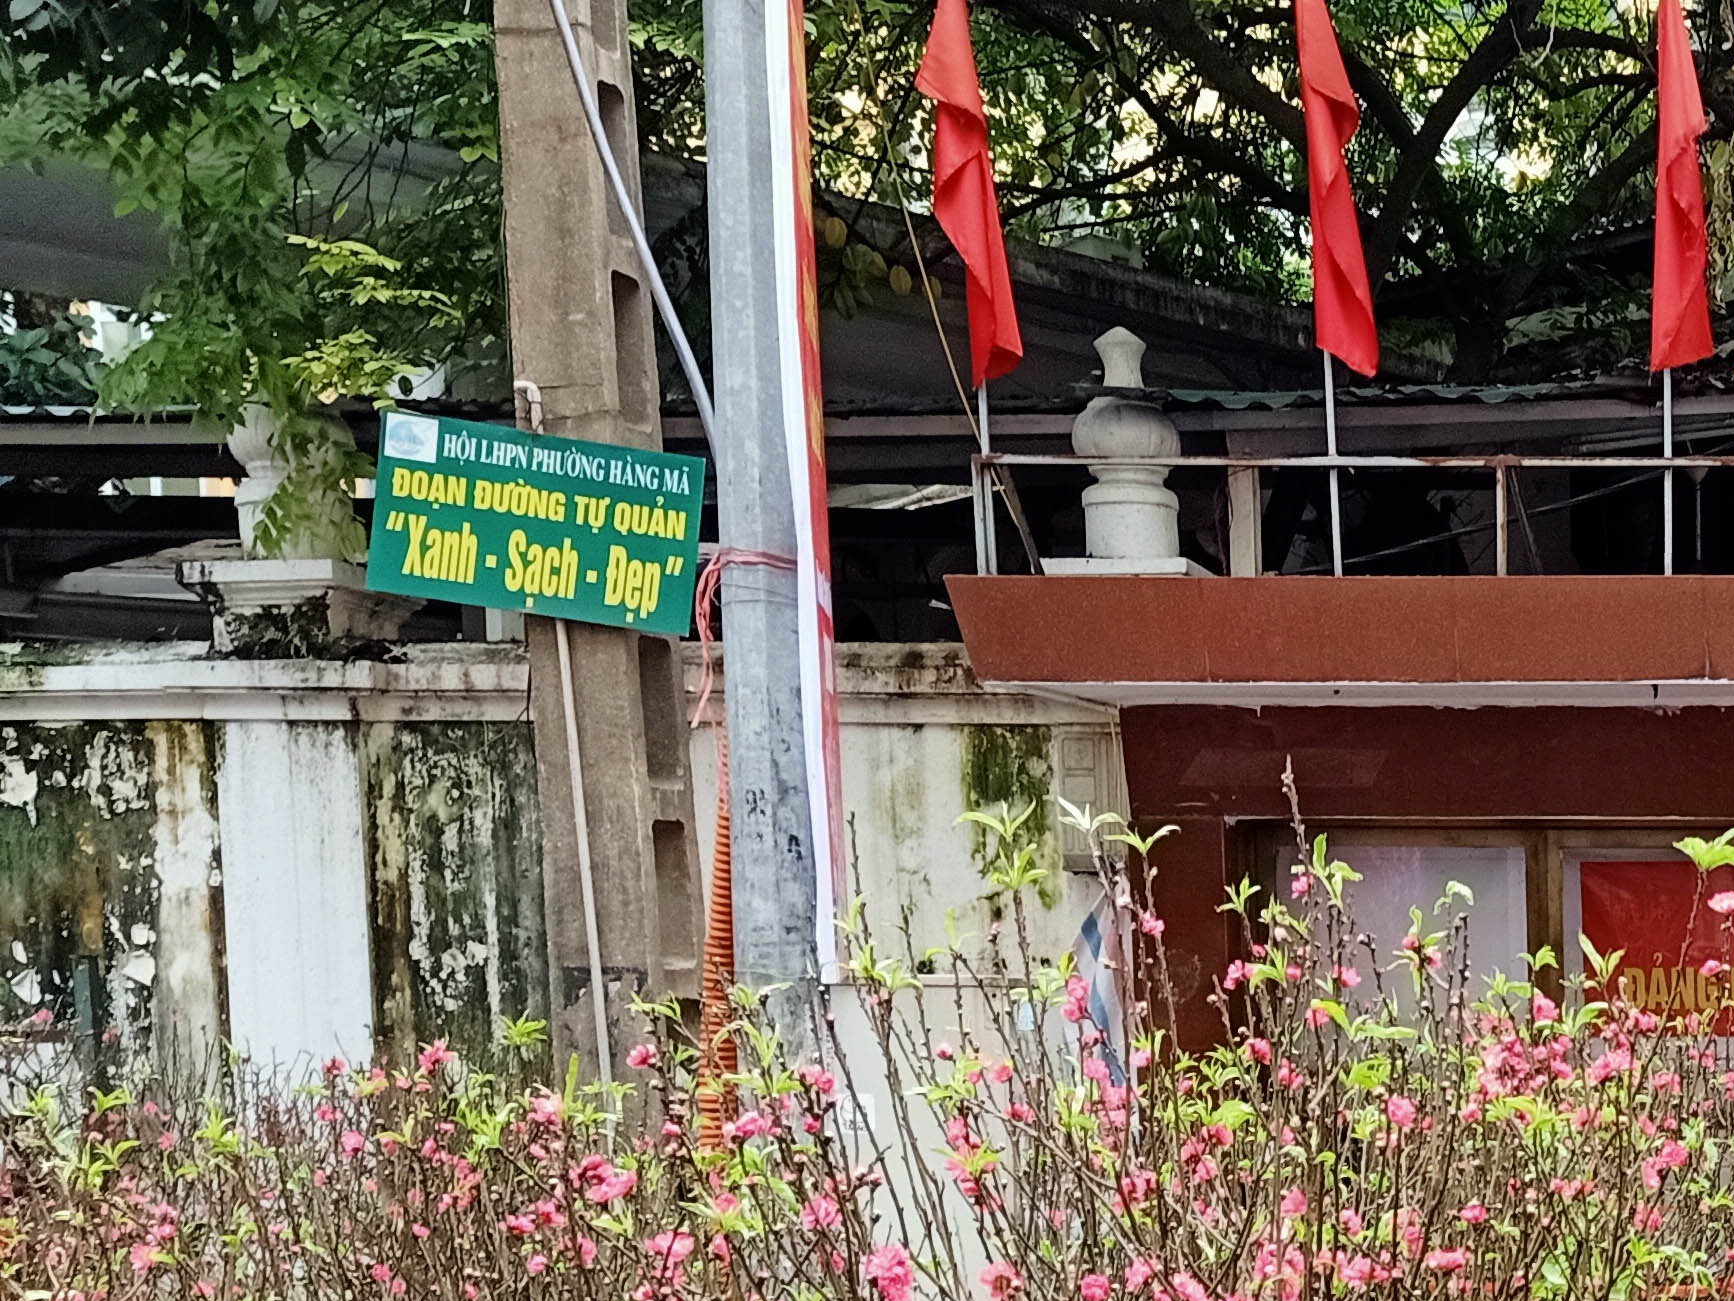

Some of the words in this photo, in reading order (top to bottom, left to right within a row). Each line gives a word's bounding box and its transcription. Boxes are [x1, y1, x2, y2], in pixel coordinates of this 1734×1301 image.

[443, 430, 477, 466] HỘI
[480, 439, 531, 469] LHPN
[531, 446, 606, 482] PHƯỜNG
[608, 455, 660, 488] HÀNG
[662, 463, 690, 495] MÃ
[391, 467, 467, 509] ĐOẠN
[473, 477, 566, 522] ĐƯỜNG
[574, 494, 611, 534] TỰ
[613, 495, 687, 540] QUẢN
[504, 529, 579, 608] Sạch
